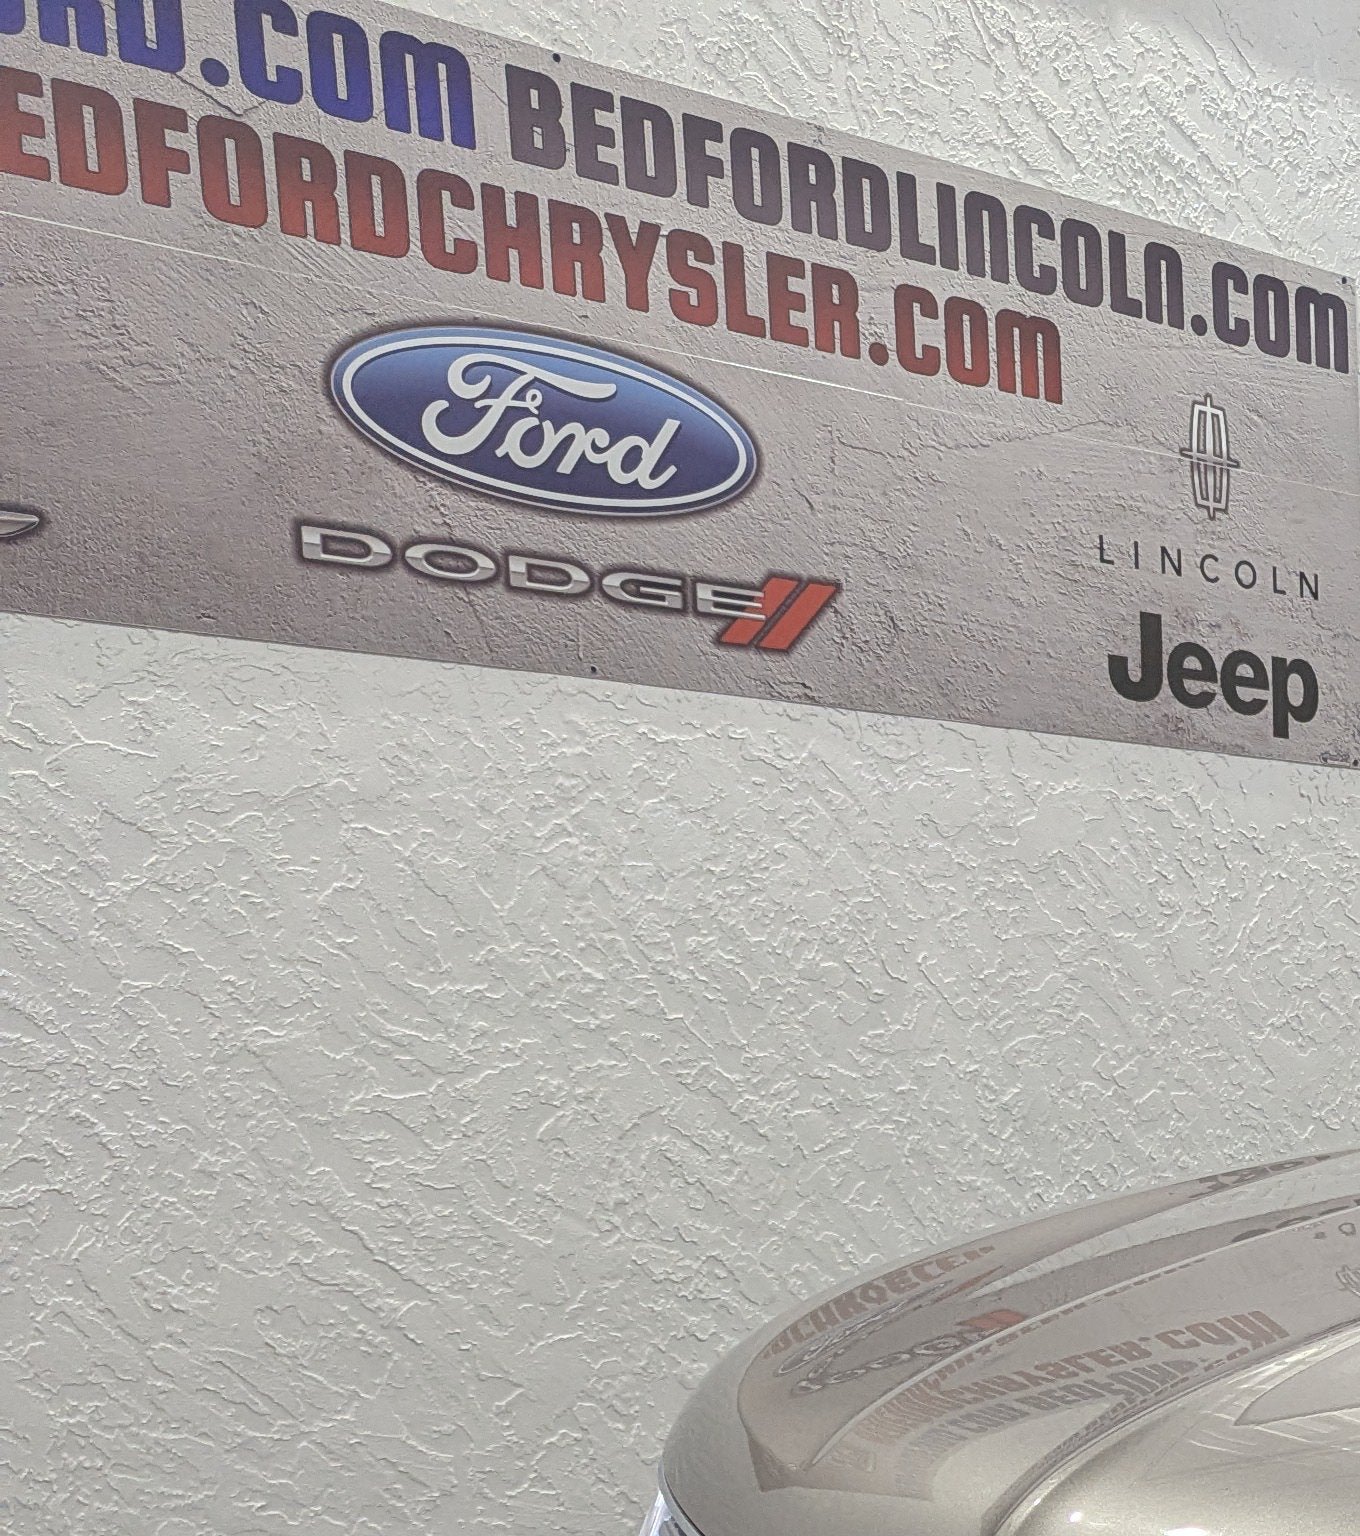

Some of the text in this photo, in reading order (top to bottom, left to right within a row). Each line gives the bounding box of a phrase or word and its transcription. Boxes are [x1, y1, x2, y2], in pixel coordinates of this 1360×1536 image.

[504, 62, 1350, 374] BEDFORDLINCOLN.COM
[421, 352, 683, 490] Ford
[300, 524, 767, 622] DODGE
[1099, 534, 1320, 601] LINCOLN
[1107, 610, 1320, 740] Jeep
